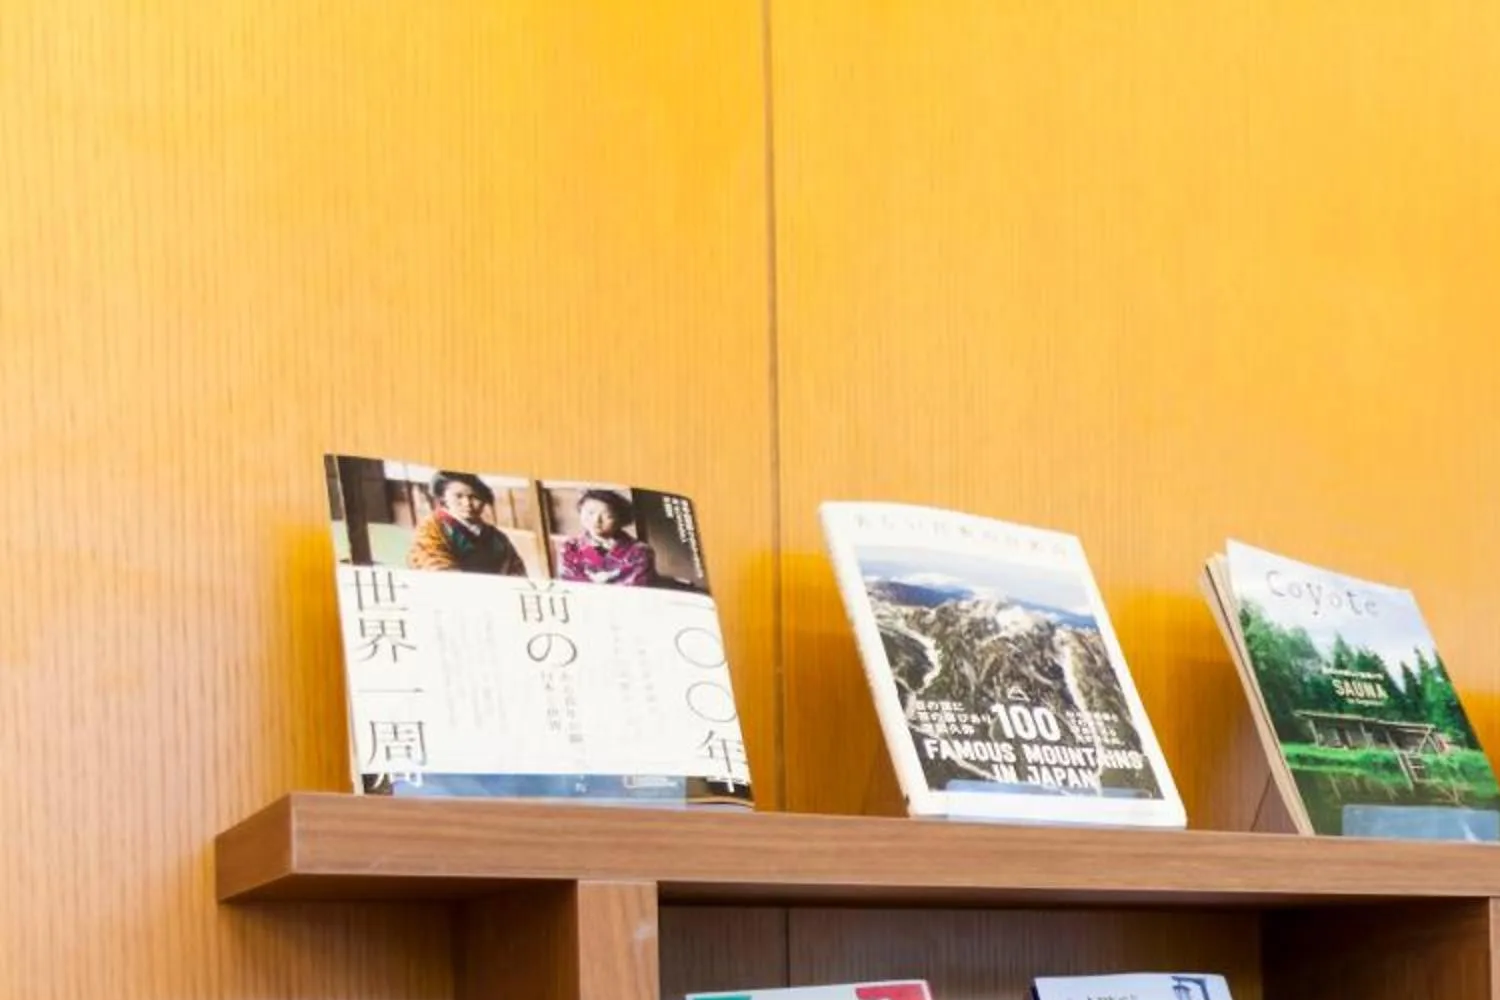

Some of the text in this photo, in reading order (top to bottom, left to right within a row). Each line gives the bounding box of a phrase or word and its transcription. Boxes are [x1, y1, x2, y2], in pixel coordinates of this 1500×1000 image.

[1265, 570, 1379, 616] Coyote
[512, 577, 577, 668] 前の
[346, 570, 428, 767] 世界一周
[1332, 678, 1389, 699] SAUNA
[991, 703, 1062, 742] 100
[924, 738, 1143, 770] FAMOUS MOUNTAINS
[992, 763, 1097, 789] IN JAPAN
